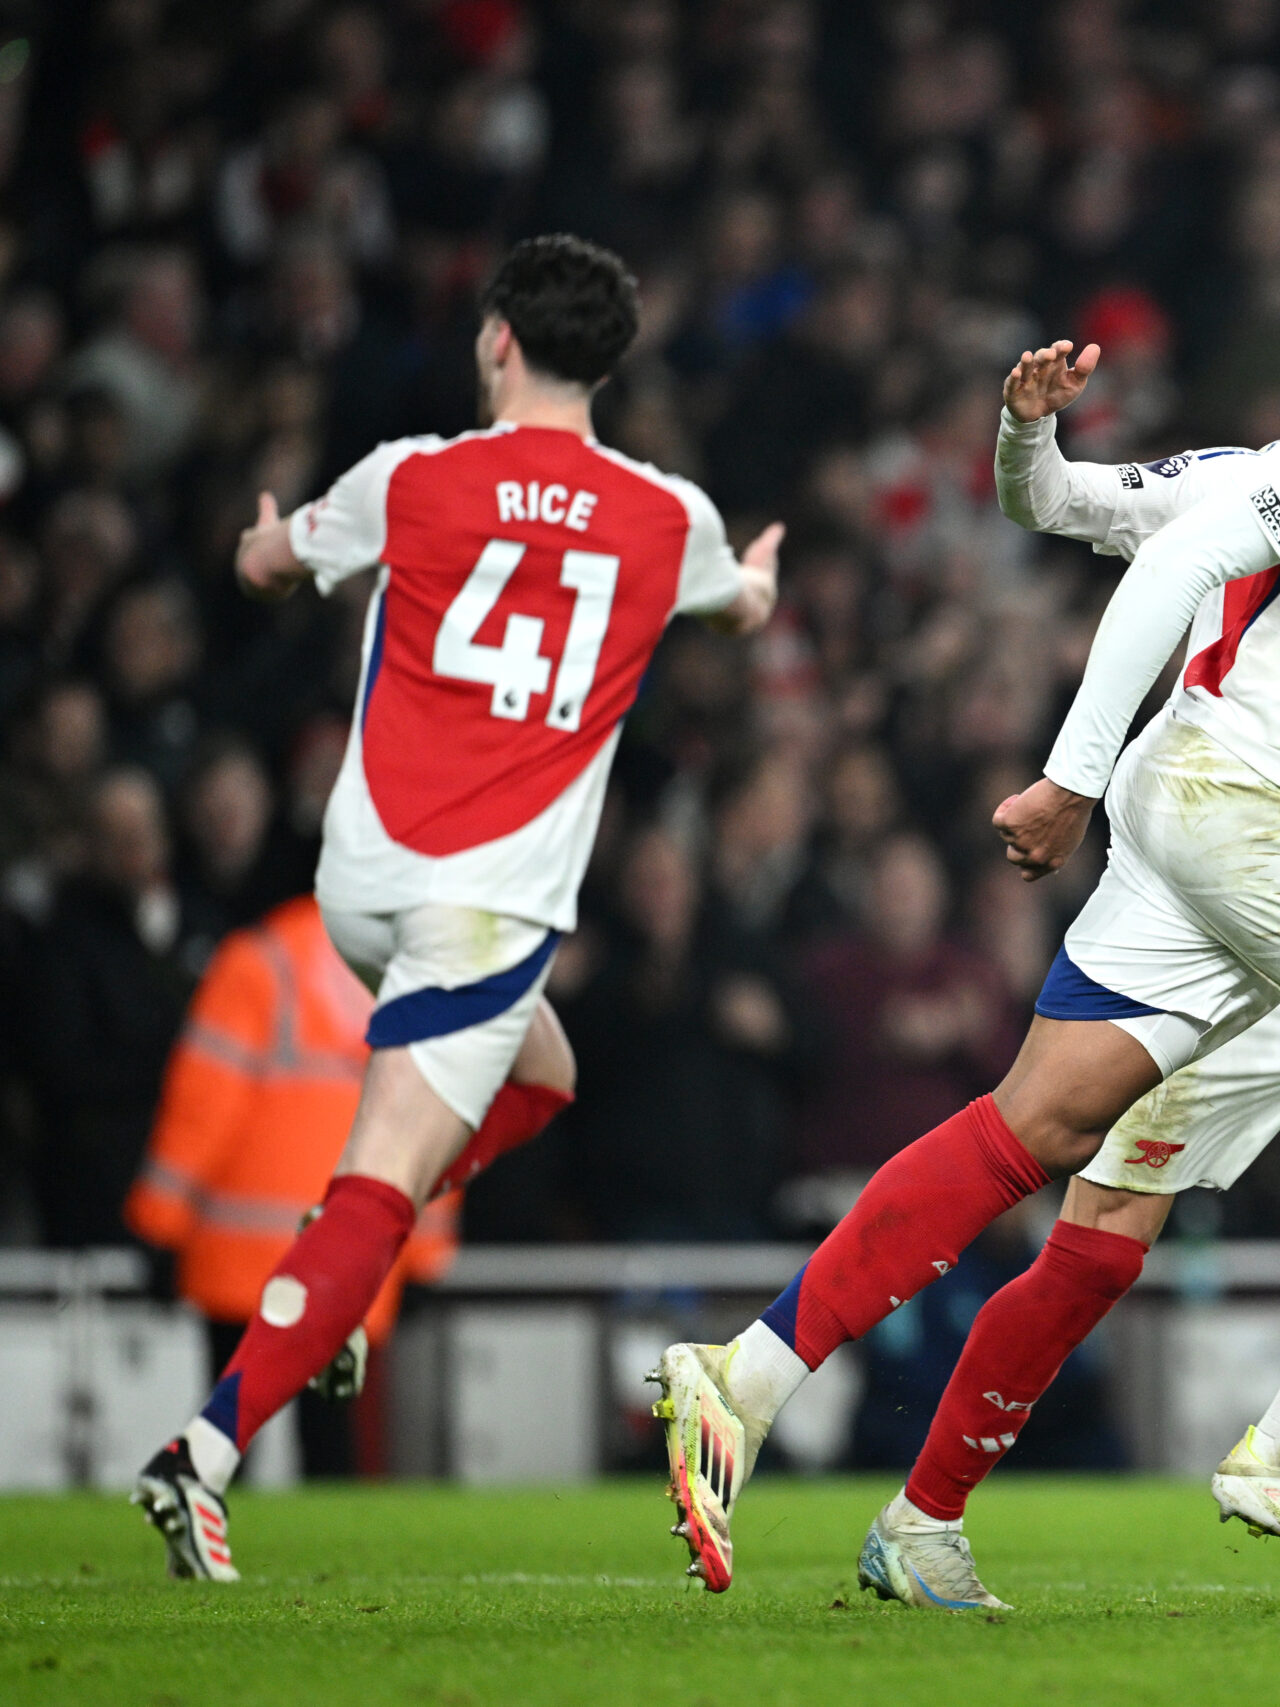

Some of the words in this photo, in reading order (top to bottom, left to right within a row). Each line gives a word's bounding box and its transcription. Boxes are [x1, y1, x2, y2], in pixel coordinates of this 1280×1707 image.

[496, 481, 598, 531] RICE
[1250, 492, 1268, 510] for
[1259, 485, 1277, 507] No
[433, 538, 620, 732] 41
